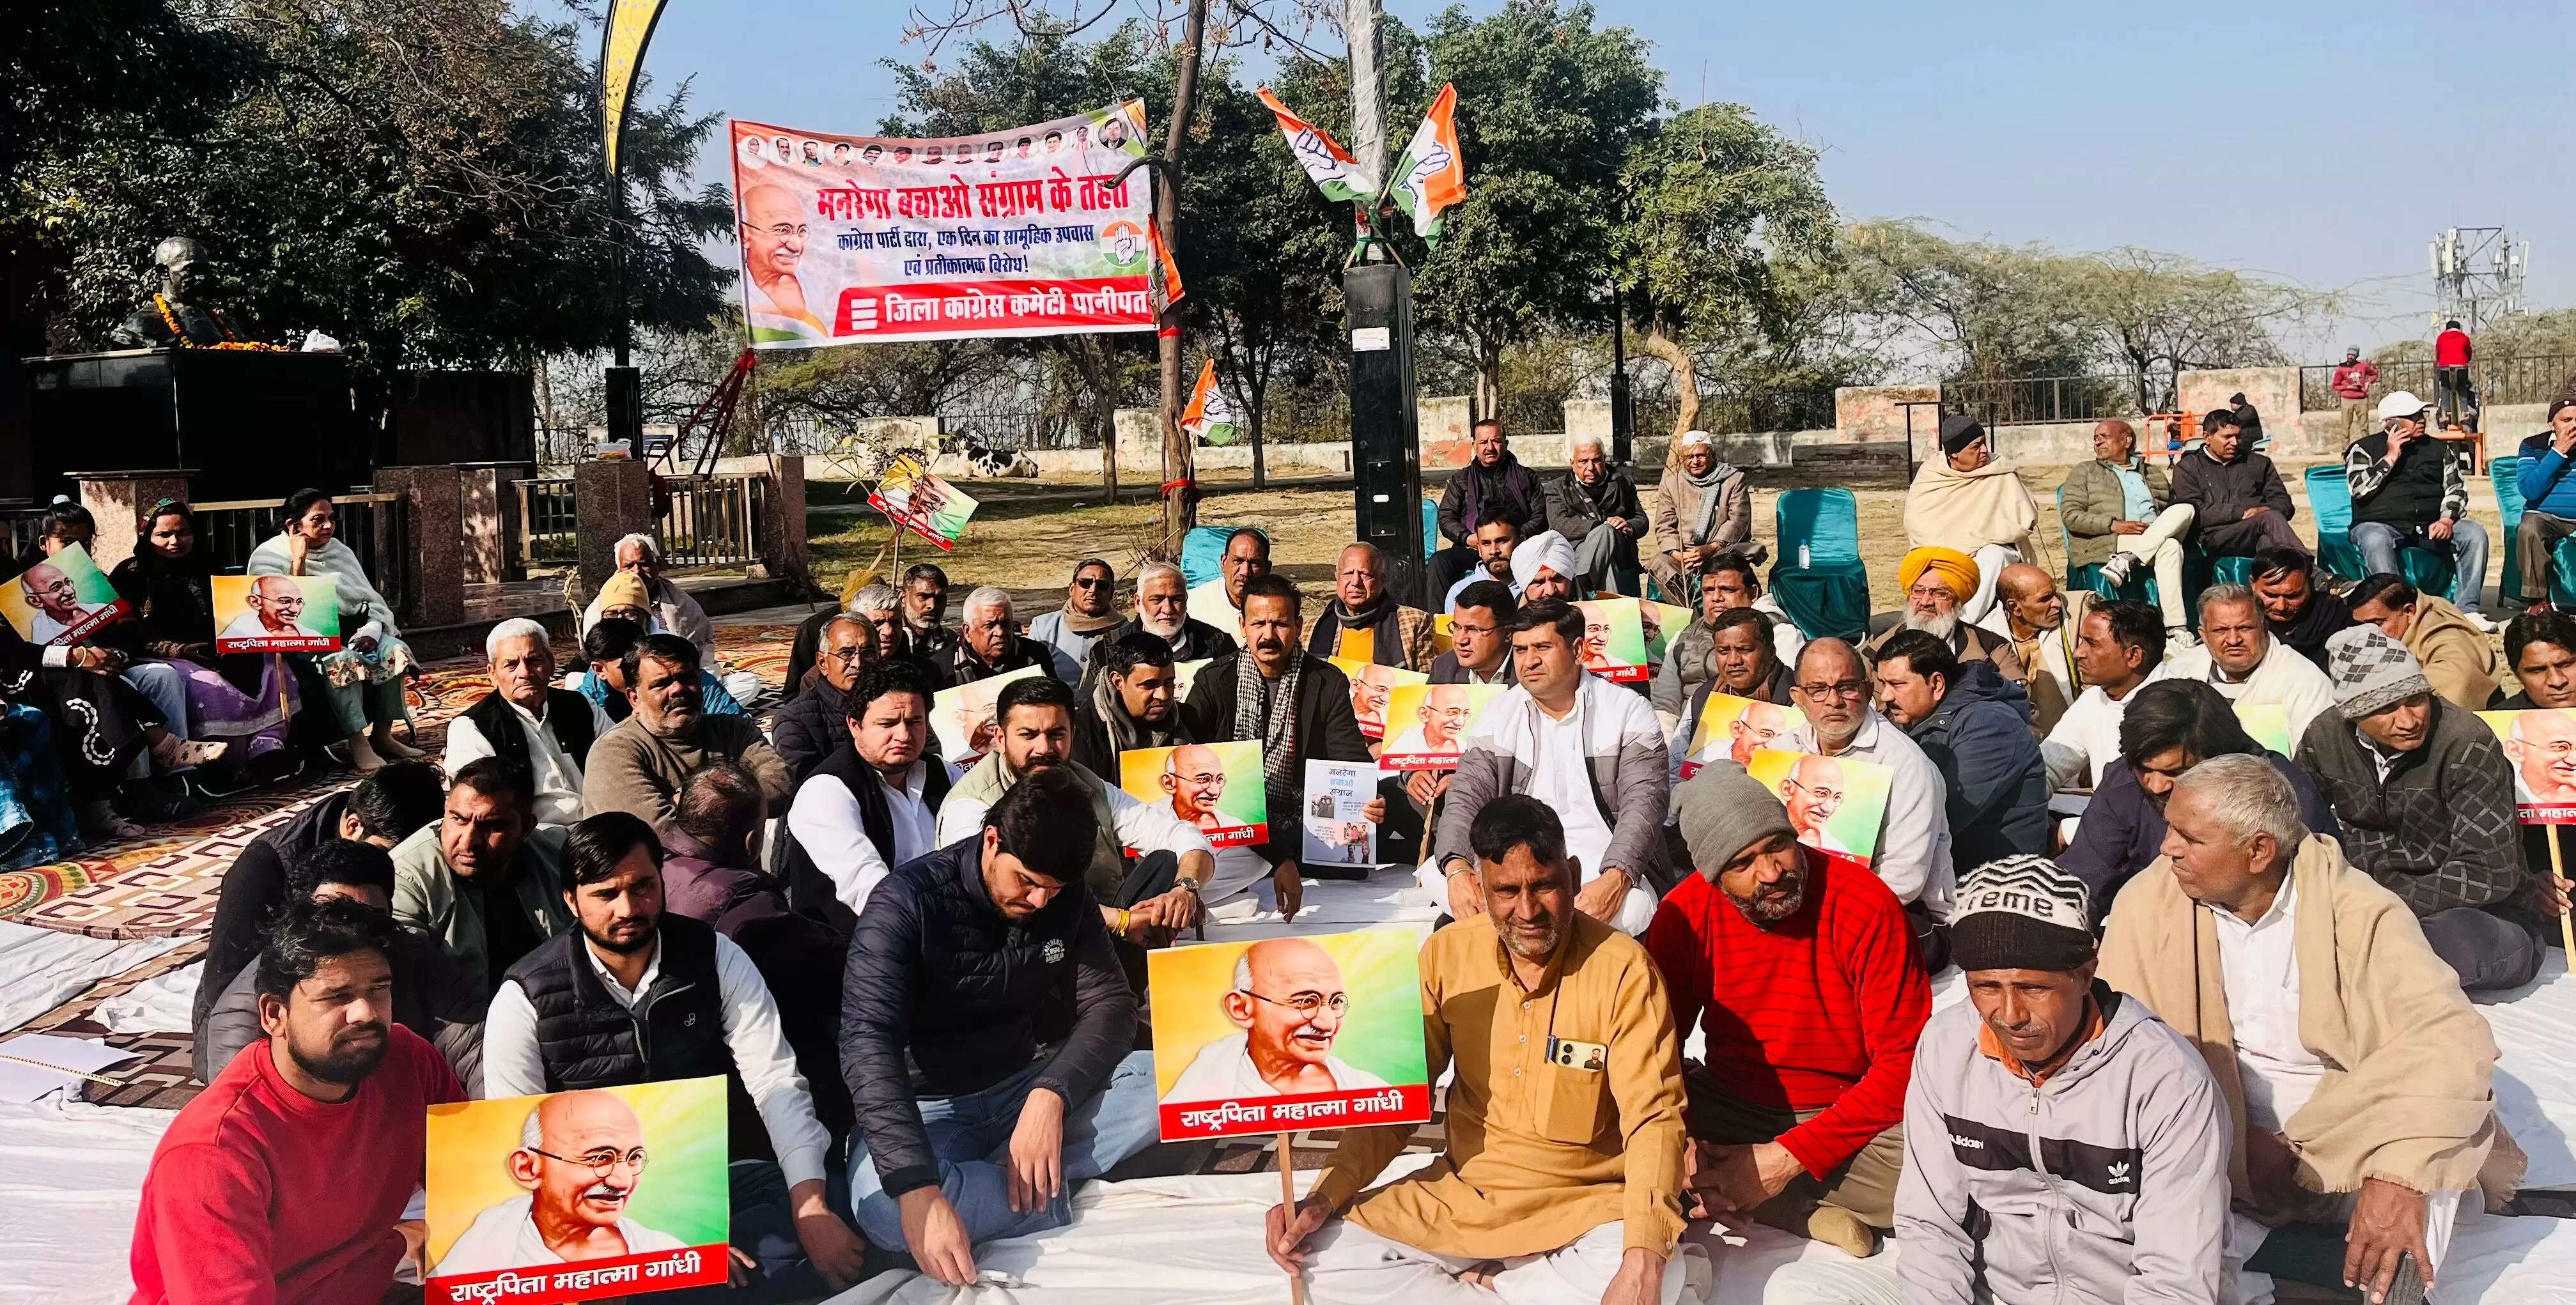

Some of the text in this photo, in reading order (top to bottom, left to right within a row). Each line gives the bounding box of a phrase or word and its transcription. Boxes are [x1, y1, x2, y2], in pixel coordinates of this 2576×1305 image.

[817, 166, 1129, 221] मनरेगा बचाओ संग्राम के तहत
[876, 226, 901, 248] पार्टी
[904, 231, 932, 251] द्वारा,
[937, 231, 956, 246] एक
[958, 226, 982, 247] दिन
[983, 230, 999, 246] का
[1004, 223, 1051, 250] सामूहिक
[1054, 225, 1094, 243] उपवास
[904, 252, 1029, 276] एवं प्रतीकात्मक विरोध!
[885, 293, 941, 323] जिला
[1009, 286, 1067, 317] कमेटी
[1071, 286, 1148, 314] पानीपत
[72, 617, 100, 637] महात्मा
[98, 605, 119, 621] गांधी
[227, 637, 330, 650] राष्ट्रपिता महात्मा गांधी
[1616, 667, 1637, 677] गांधी
[1389, 755, 1427, 768] राष्ट्रपिता
[1228, 828, 1254, 840] गांधी
[1968, 892, 2053, 918] reme
[1181, 1089, 1404, 1131] राष्ट्रपिता महात्मा गांधी
[450, 1250, 702, 1305] राष्ट्रपिता महात्मा गांधी
